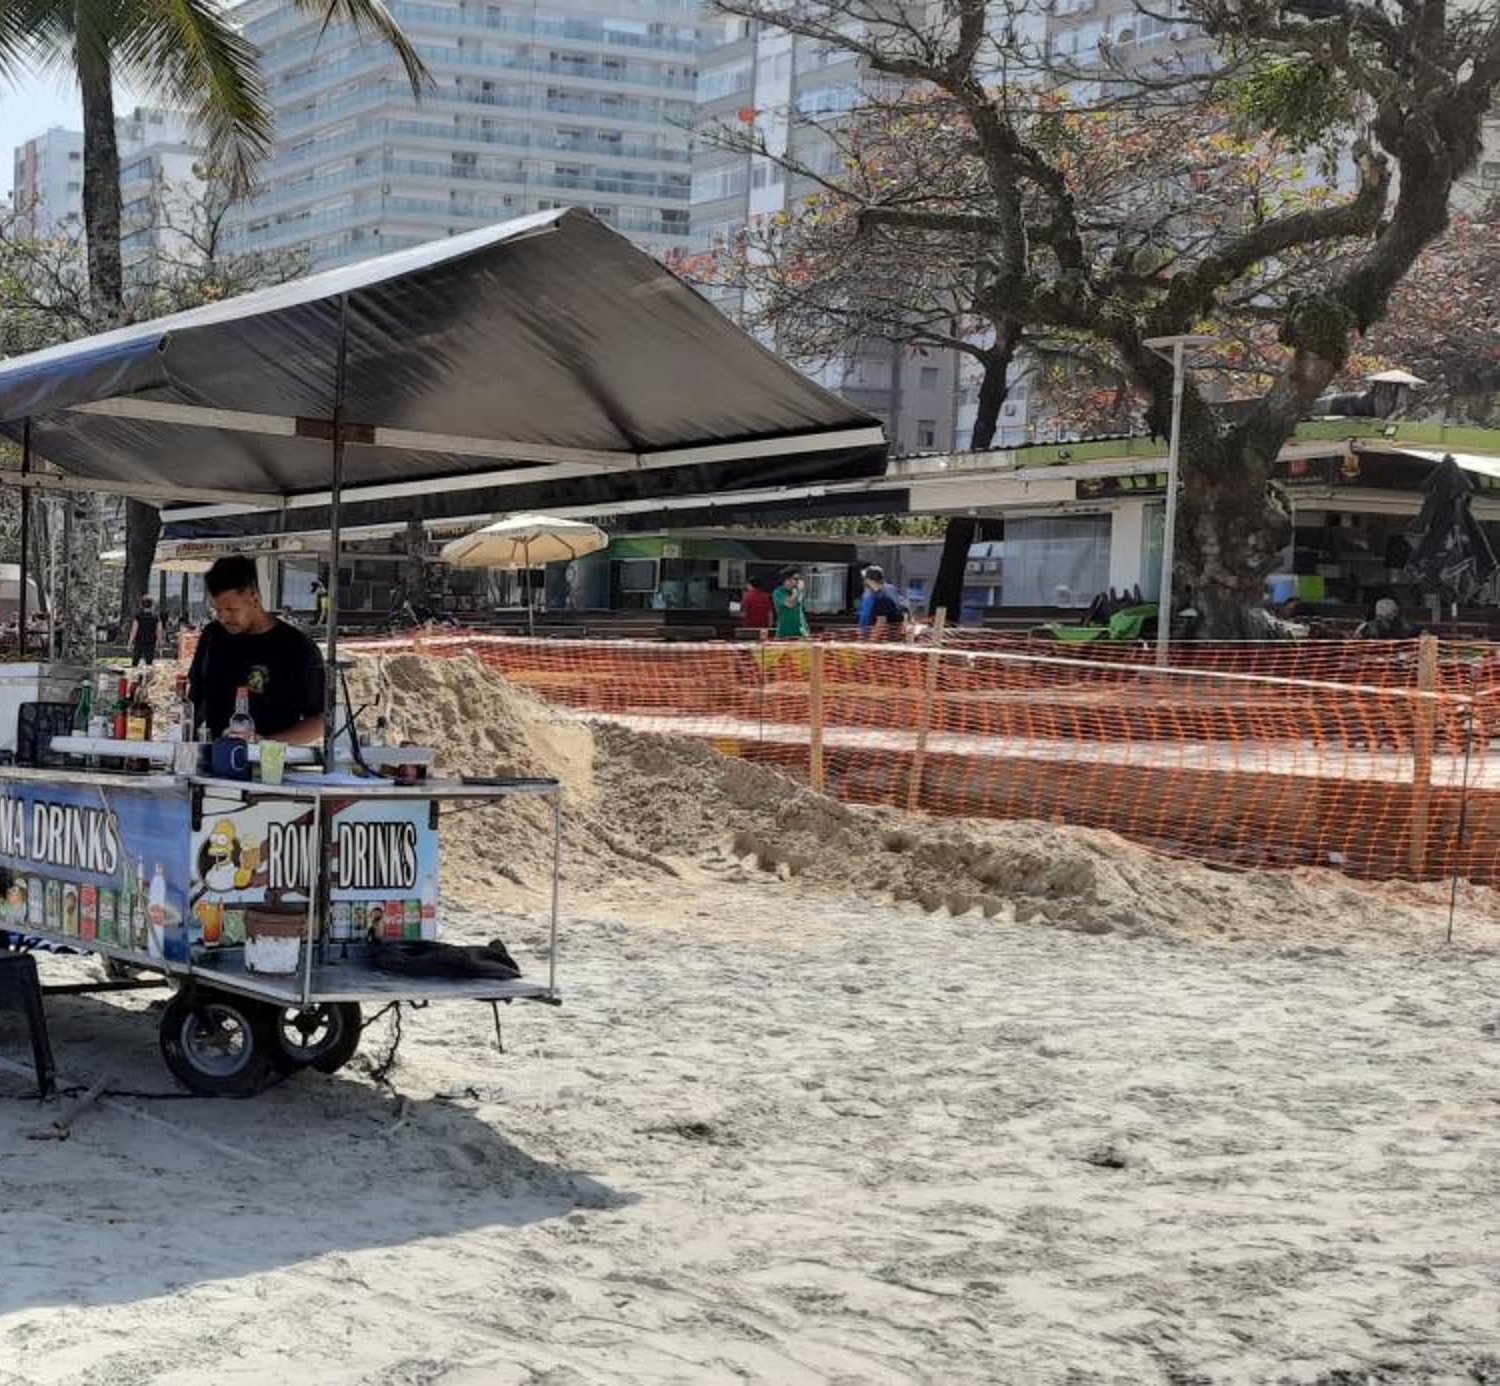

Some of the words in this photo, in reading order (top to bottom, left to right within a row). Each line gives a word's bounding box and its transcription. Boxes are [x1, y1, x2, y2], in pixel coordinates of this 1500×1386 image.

[31, 801, 119, 876] DRINKS
[268, 822, 323, 890] ROM
[338, 822, 417, 890] DRINKS
